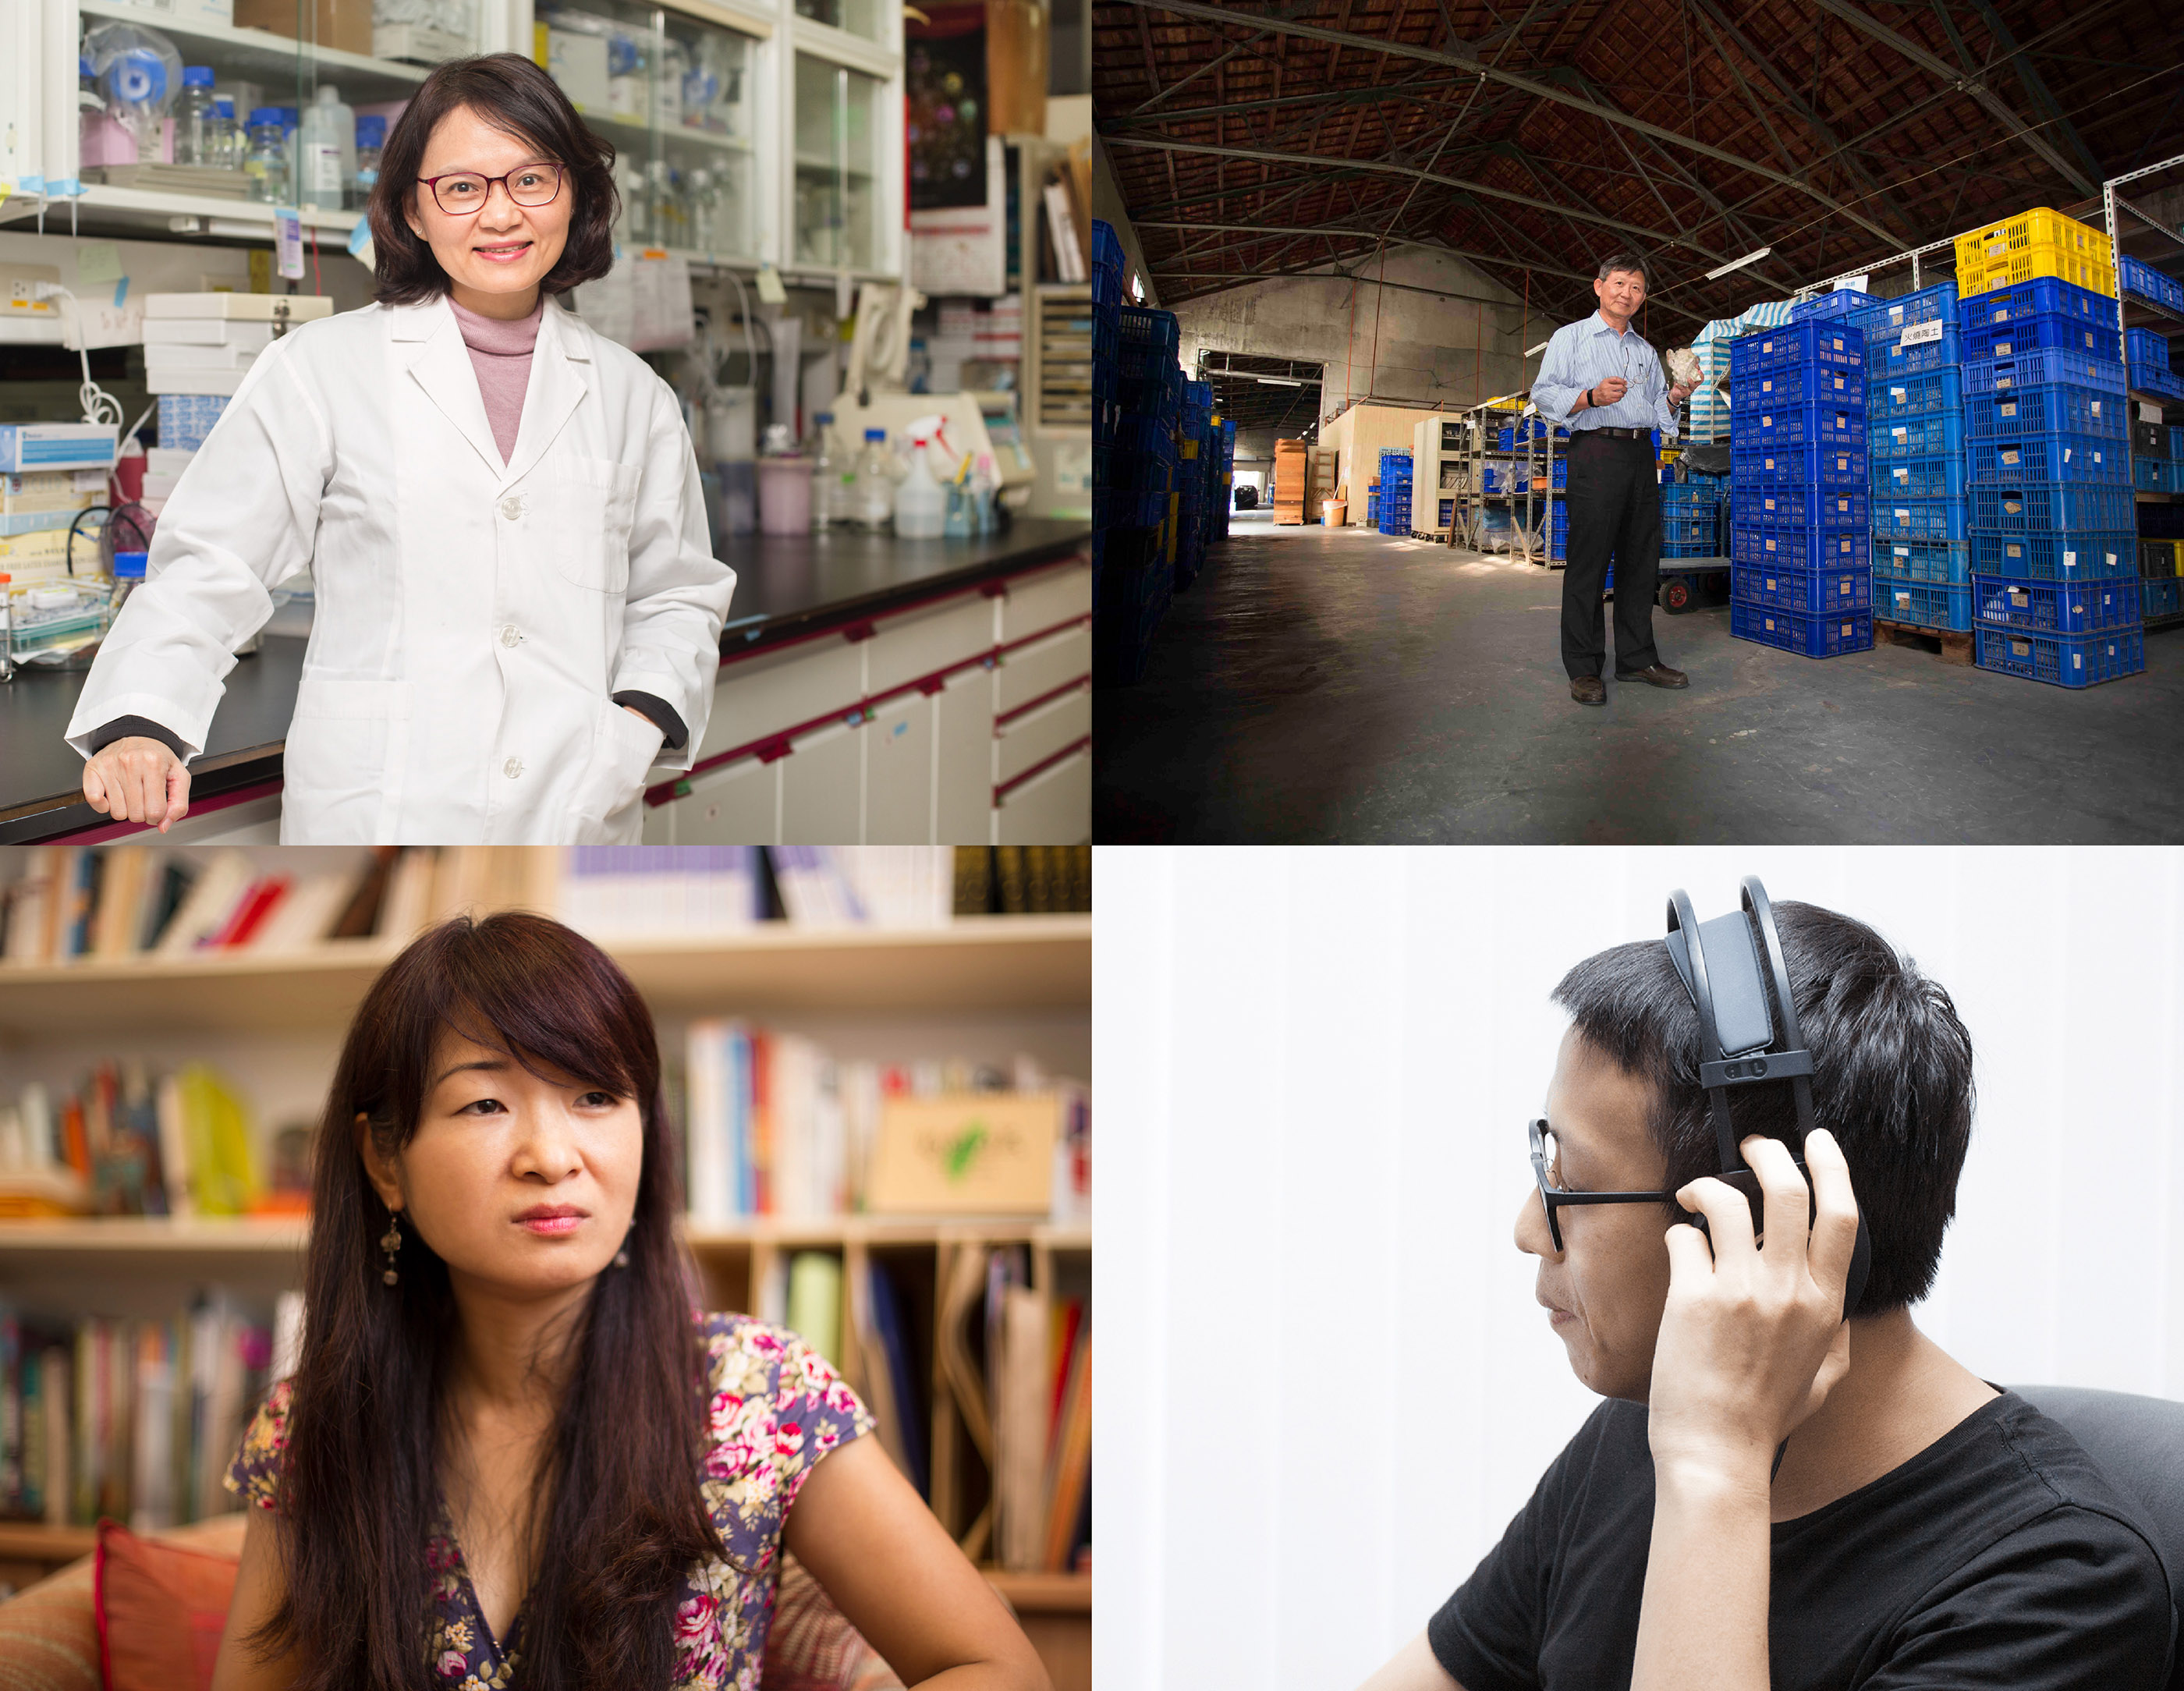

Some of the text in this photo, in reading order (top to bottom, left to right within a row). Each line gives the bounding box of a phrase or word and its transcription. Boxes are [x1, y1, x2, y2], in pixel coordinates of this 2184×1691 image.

[1904, 327, 1939, 342] 火燒陶土
[1754, 1062, 1763, 1073] L
